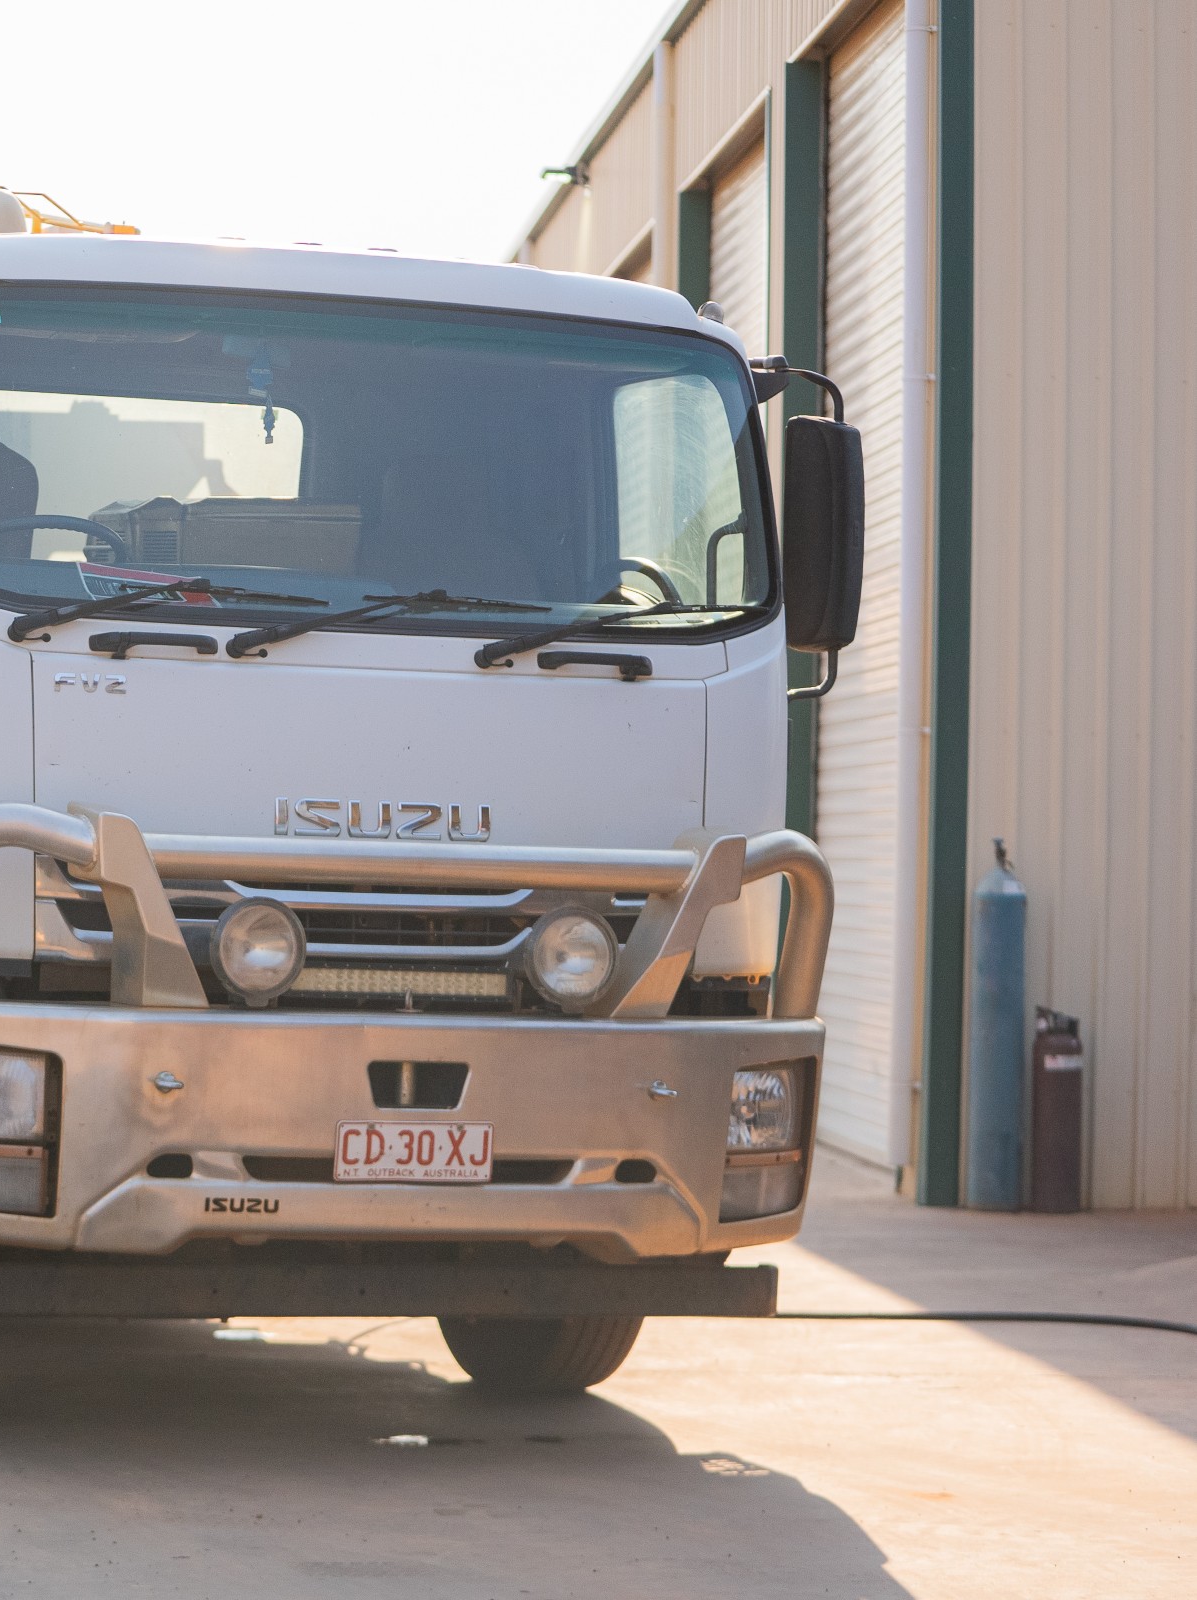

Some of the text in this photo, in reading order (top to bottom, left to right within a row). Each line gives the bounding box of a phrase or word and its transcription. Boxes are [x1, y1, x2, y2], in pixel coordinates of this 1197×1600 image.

[273, 796, 491, 842] ISUZU
[367, 1168, 416, 1178] OUTBACK
[422, 1168, 479, 1178] AUSTRALIA
[204, 1196, 280, 1214] ISUZU
